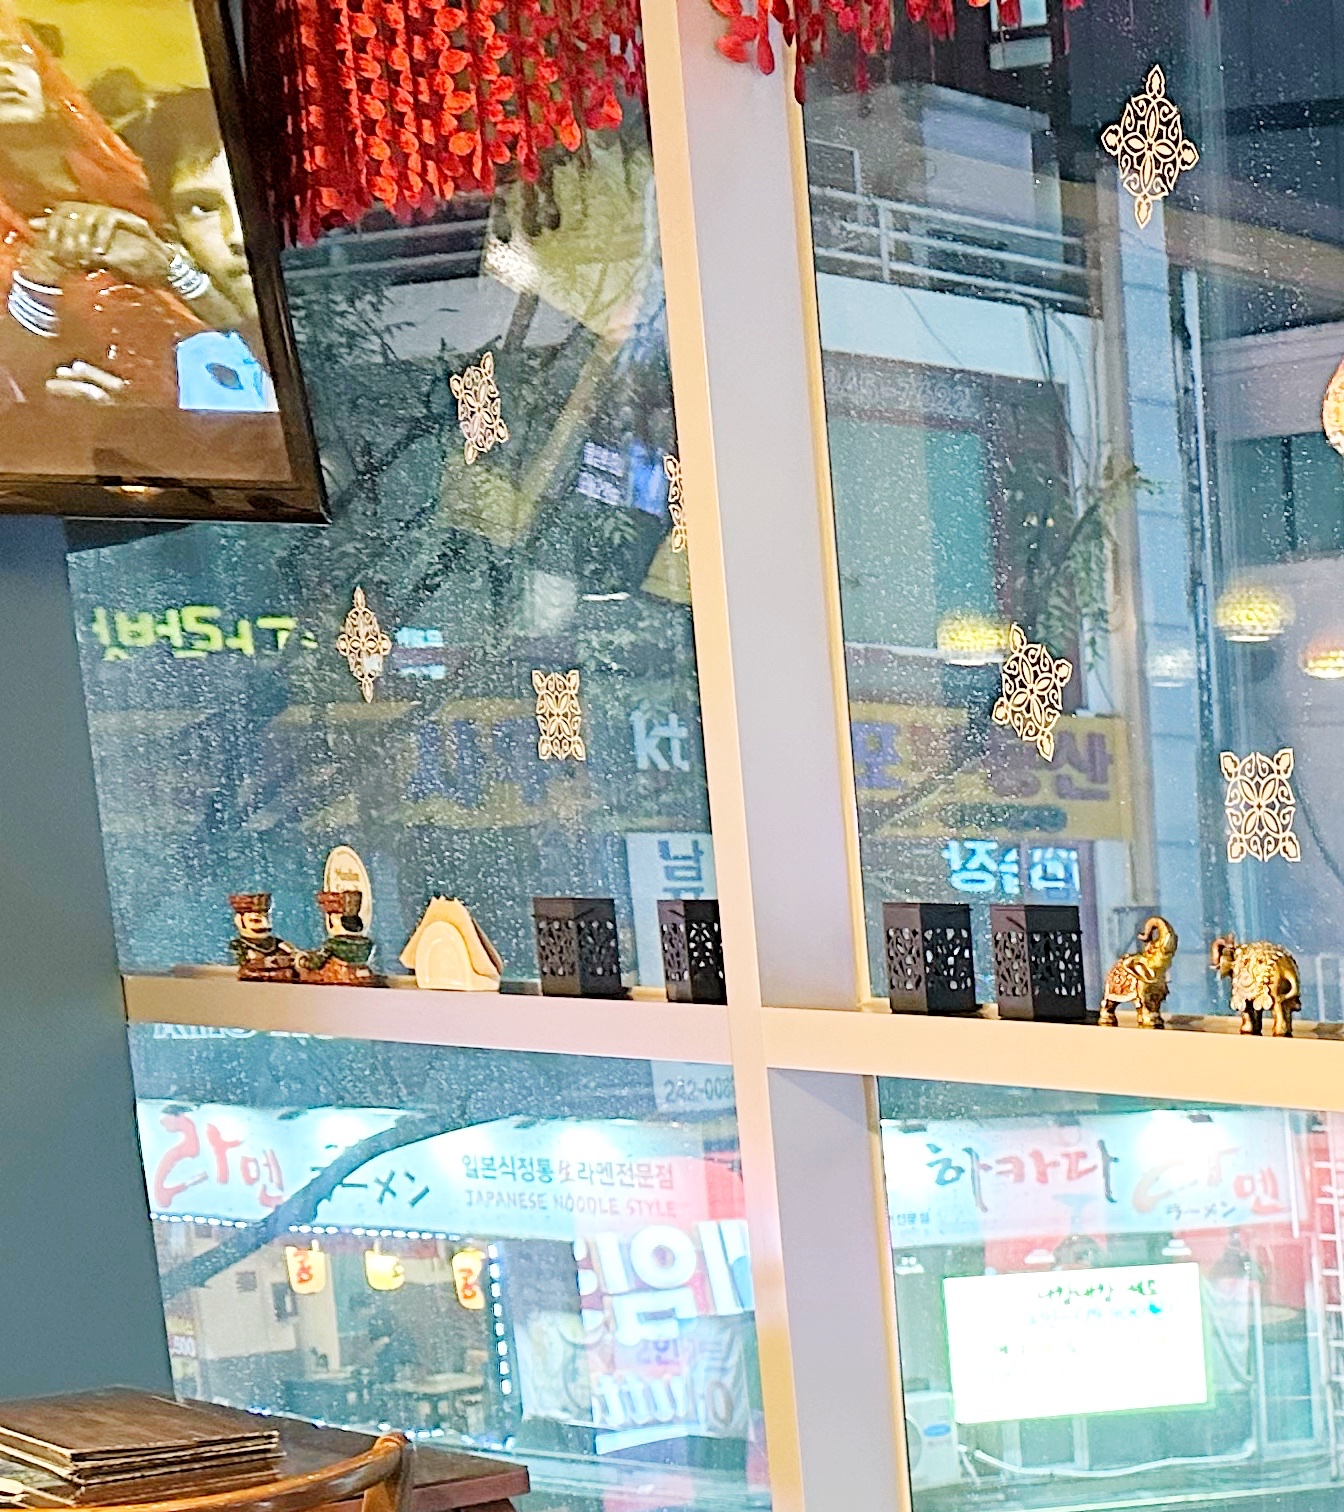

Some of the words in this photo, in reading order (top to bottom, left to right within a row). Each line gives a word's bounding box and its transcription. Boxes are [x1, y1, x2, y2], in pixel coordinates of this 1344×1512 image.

[629, 708, 691, 772] kt
[465, 1189, 548, 1212] JAPANESE
[552, 1193, 621, 1216] NOODLE
[626, 1197, 678, 1218] STYLE
